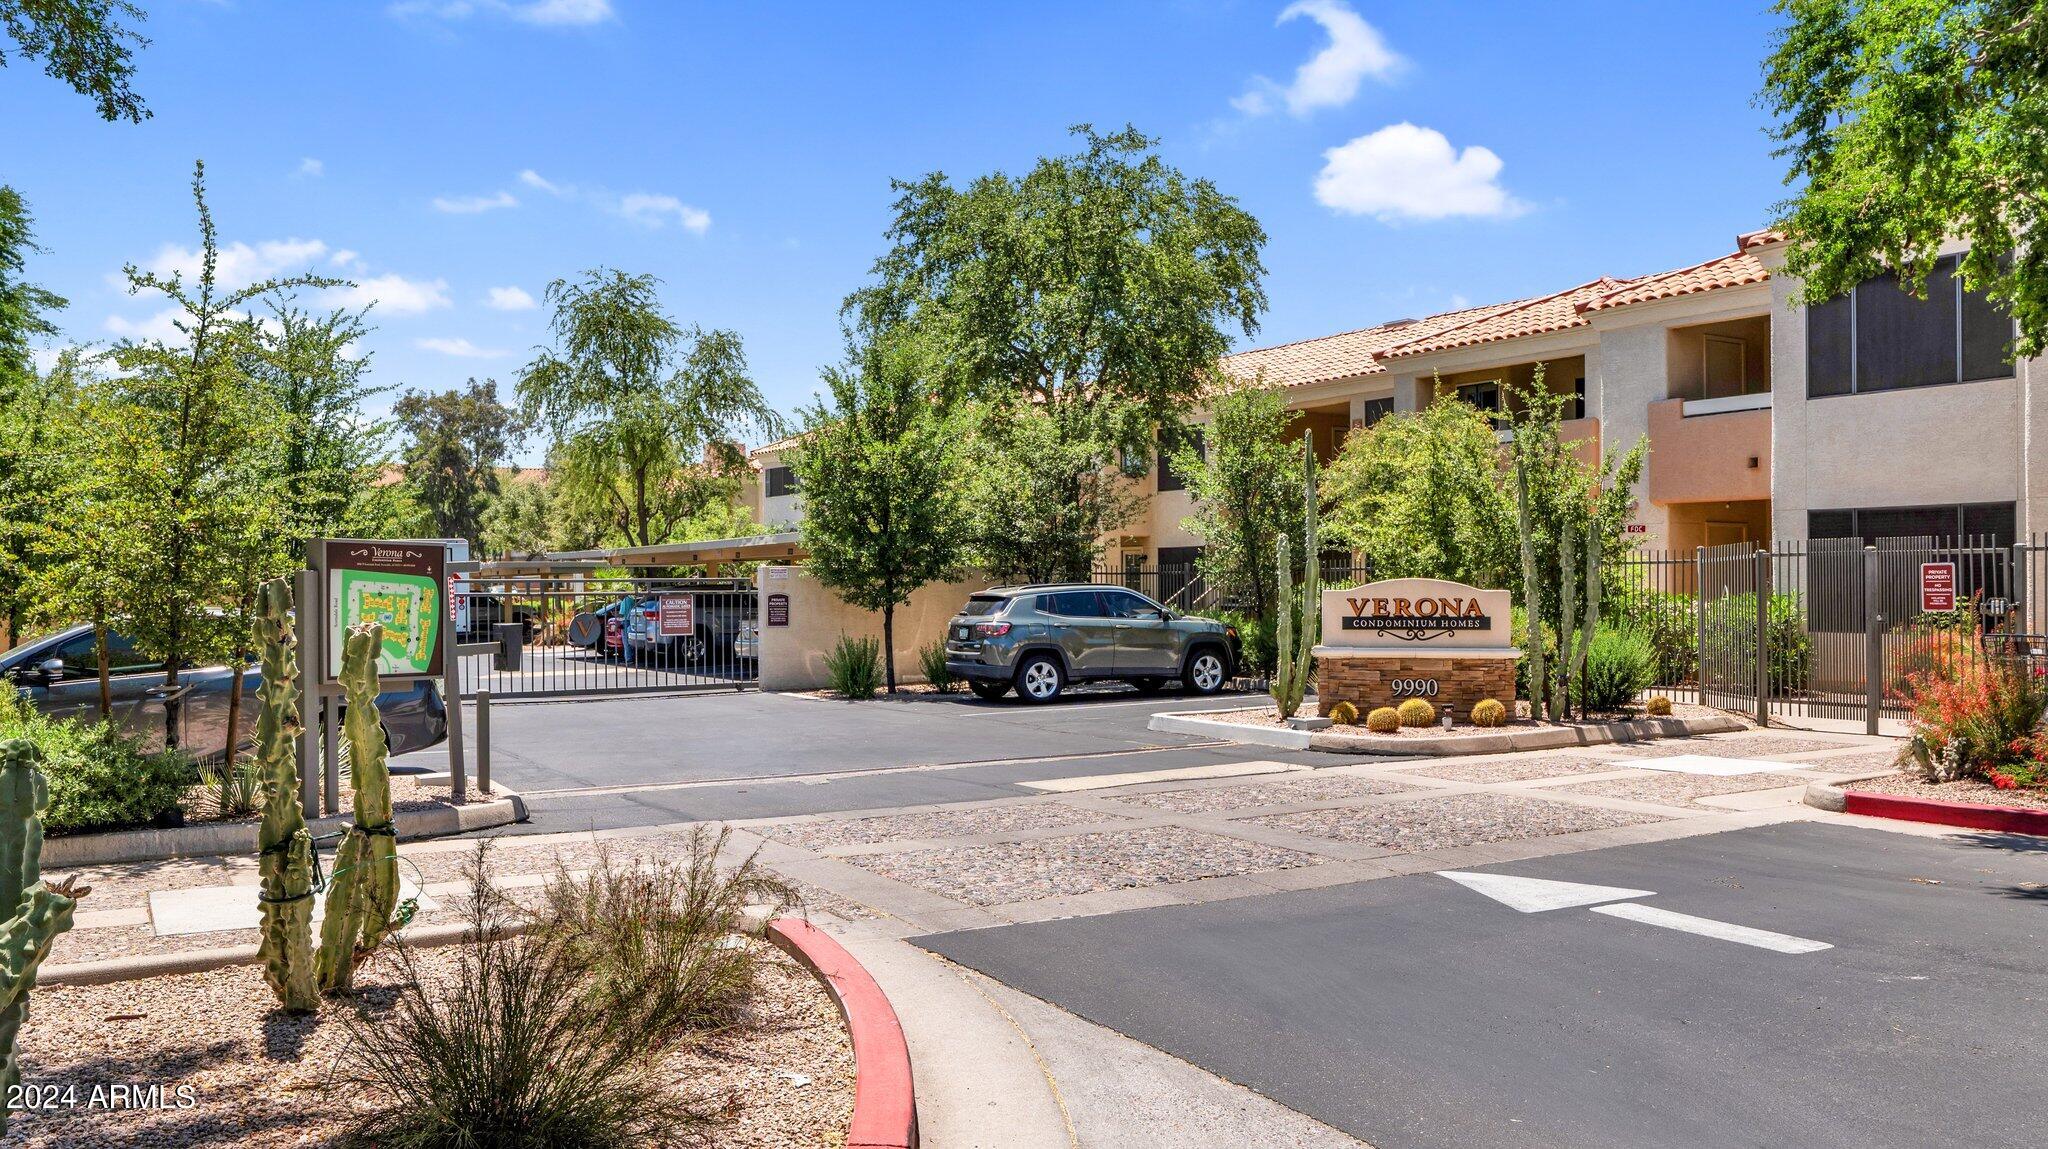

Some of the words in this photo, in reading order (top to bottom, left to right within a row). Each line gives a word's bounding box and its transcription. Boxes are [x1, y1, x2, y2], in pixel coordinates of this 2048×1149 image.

[371, 546, 403, 558] Verona
[1346, 597, 1485, 617] VERONA
[576, 620, 593, 640] V
[1353, 620, 1437, 628] CONDOMINIUM
[1441, 620, 1480, 628] HOMES
[1391, 678, 1438, 696] 9990
